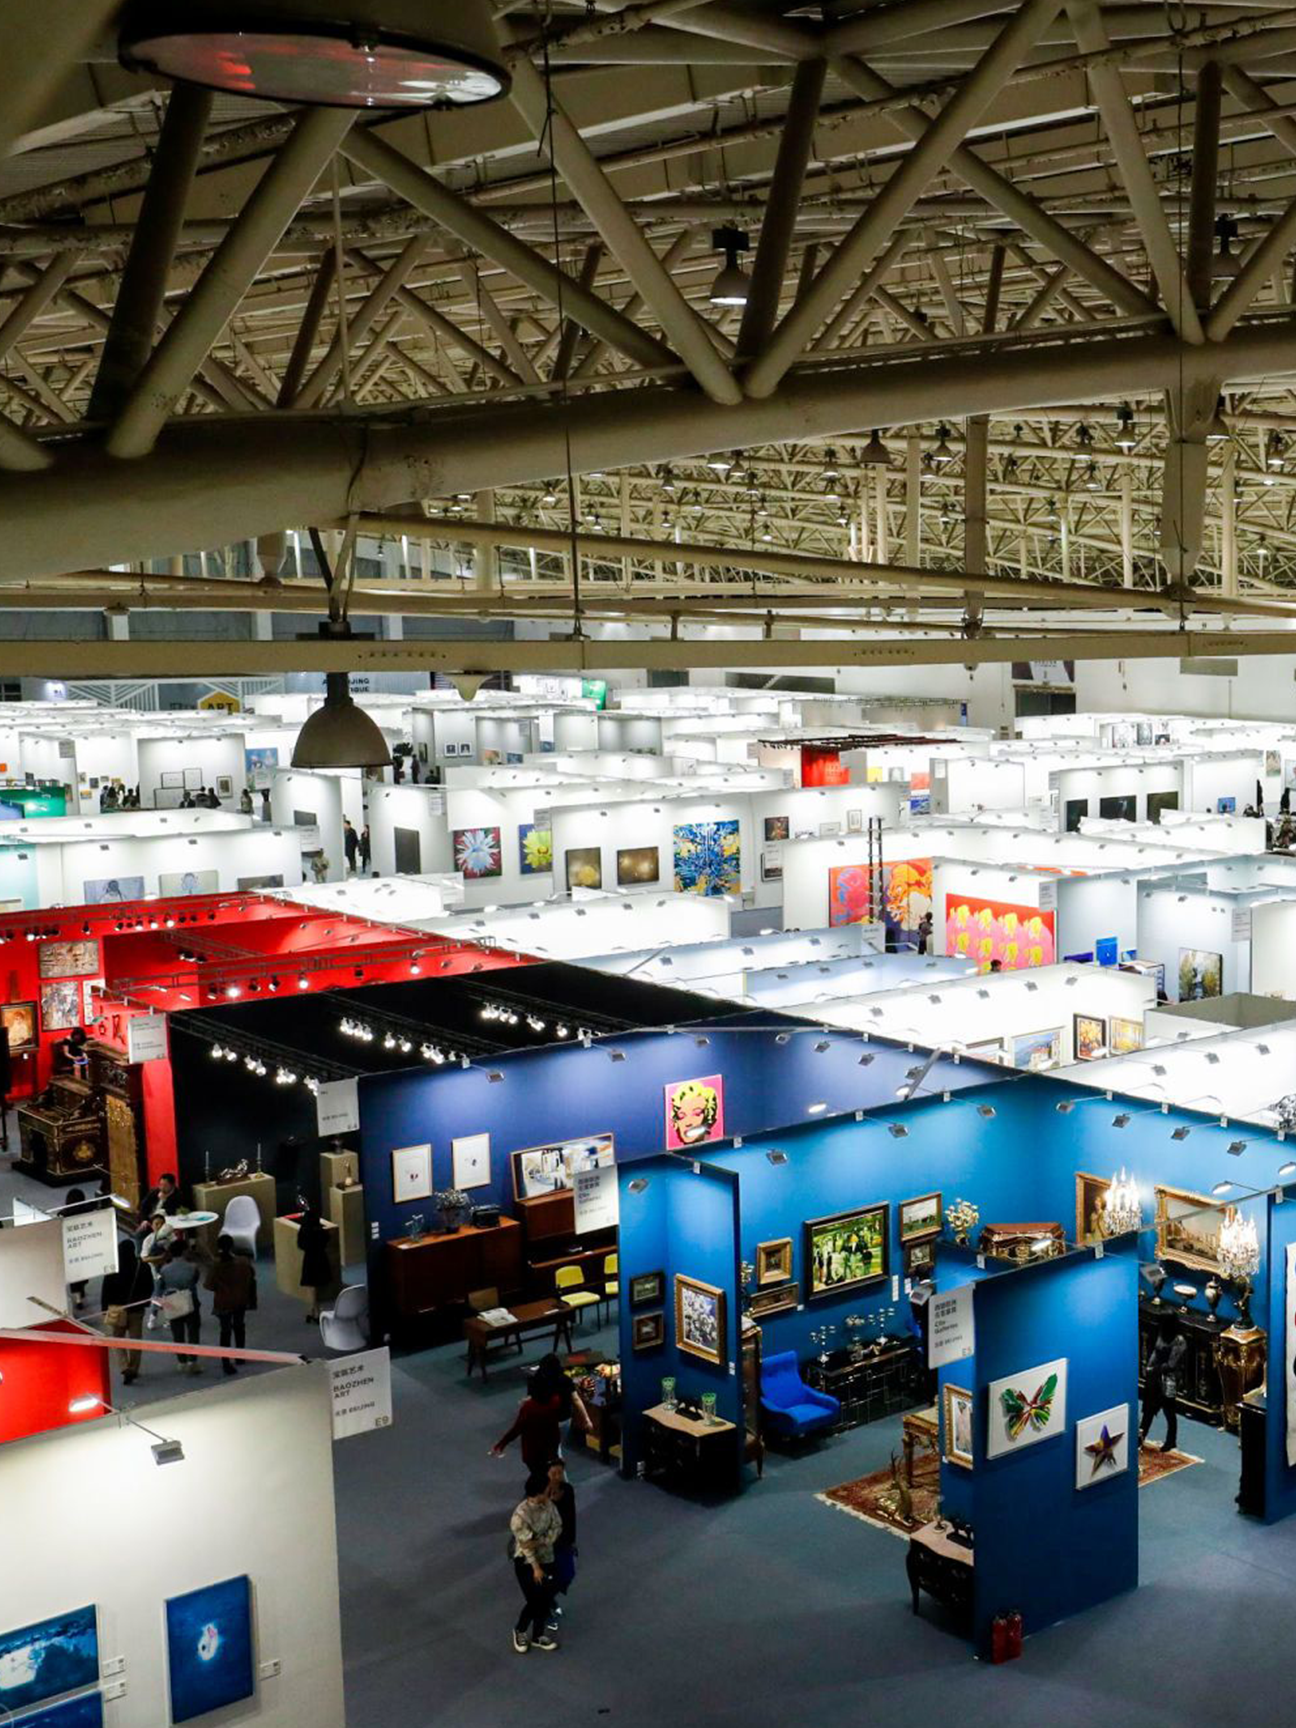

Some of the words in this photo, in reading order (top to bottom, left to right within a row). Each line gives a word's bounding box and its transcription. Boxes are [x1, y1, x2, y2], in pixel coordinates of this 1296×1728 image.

[333, 1376, 375, 1393] BAOZHEN
[334, 1389, 350, 1399] ART
[375, 1415, 389, 1427] E9
